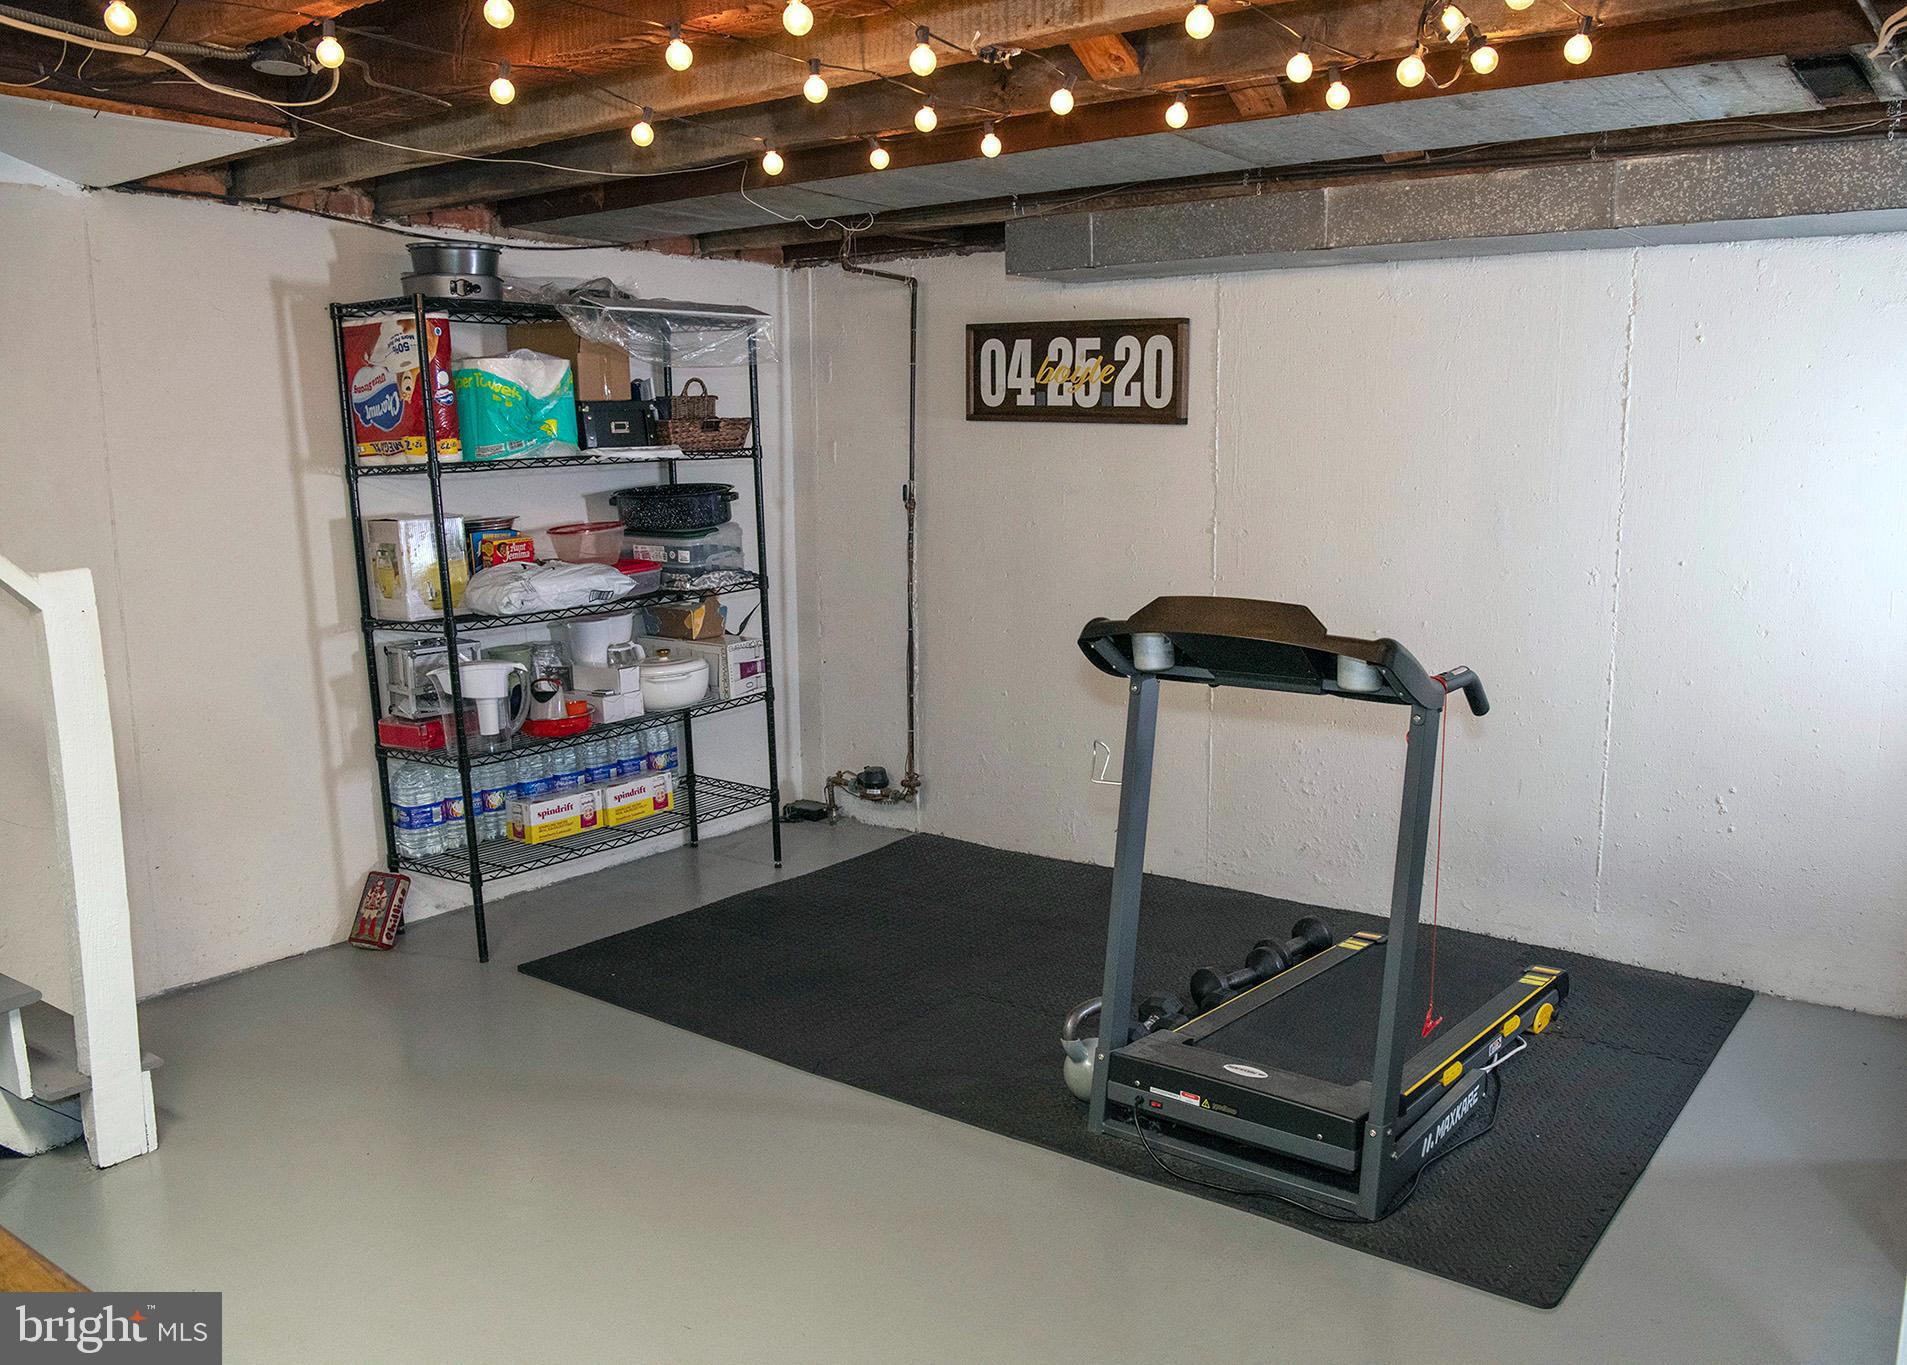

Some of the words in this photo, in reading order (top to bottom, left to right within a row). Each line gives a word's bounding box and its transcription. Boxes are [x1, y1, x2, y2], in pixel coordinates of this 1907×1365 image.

[1036, 355, 1116, 393] boyle
[353, 382, 372, 394] Strong
[364, 391, 400, 420] Charmin
[502, 546, 531, 563] Jemima
[510, 542, 527, 553] Aunt
[613, 785, 646, 803] spindrift
[537, 802, 574, 820] spindrift
[1435, 1084, 1480, 1144] MAXKARE
